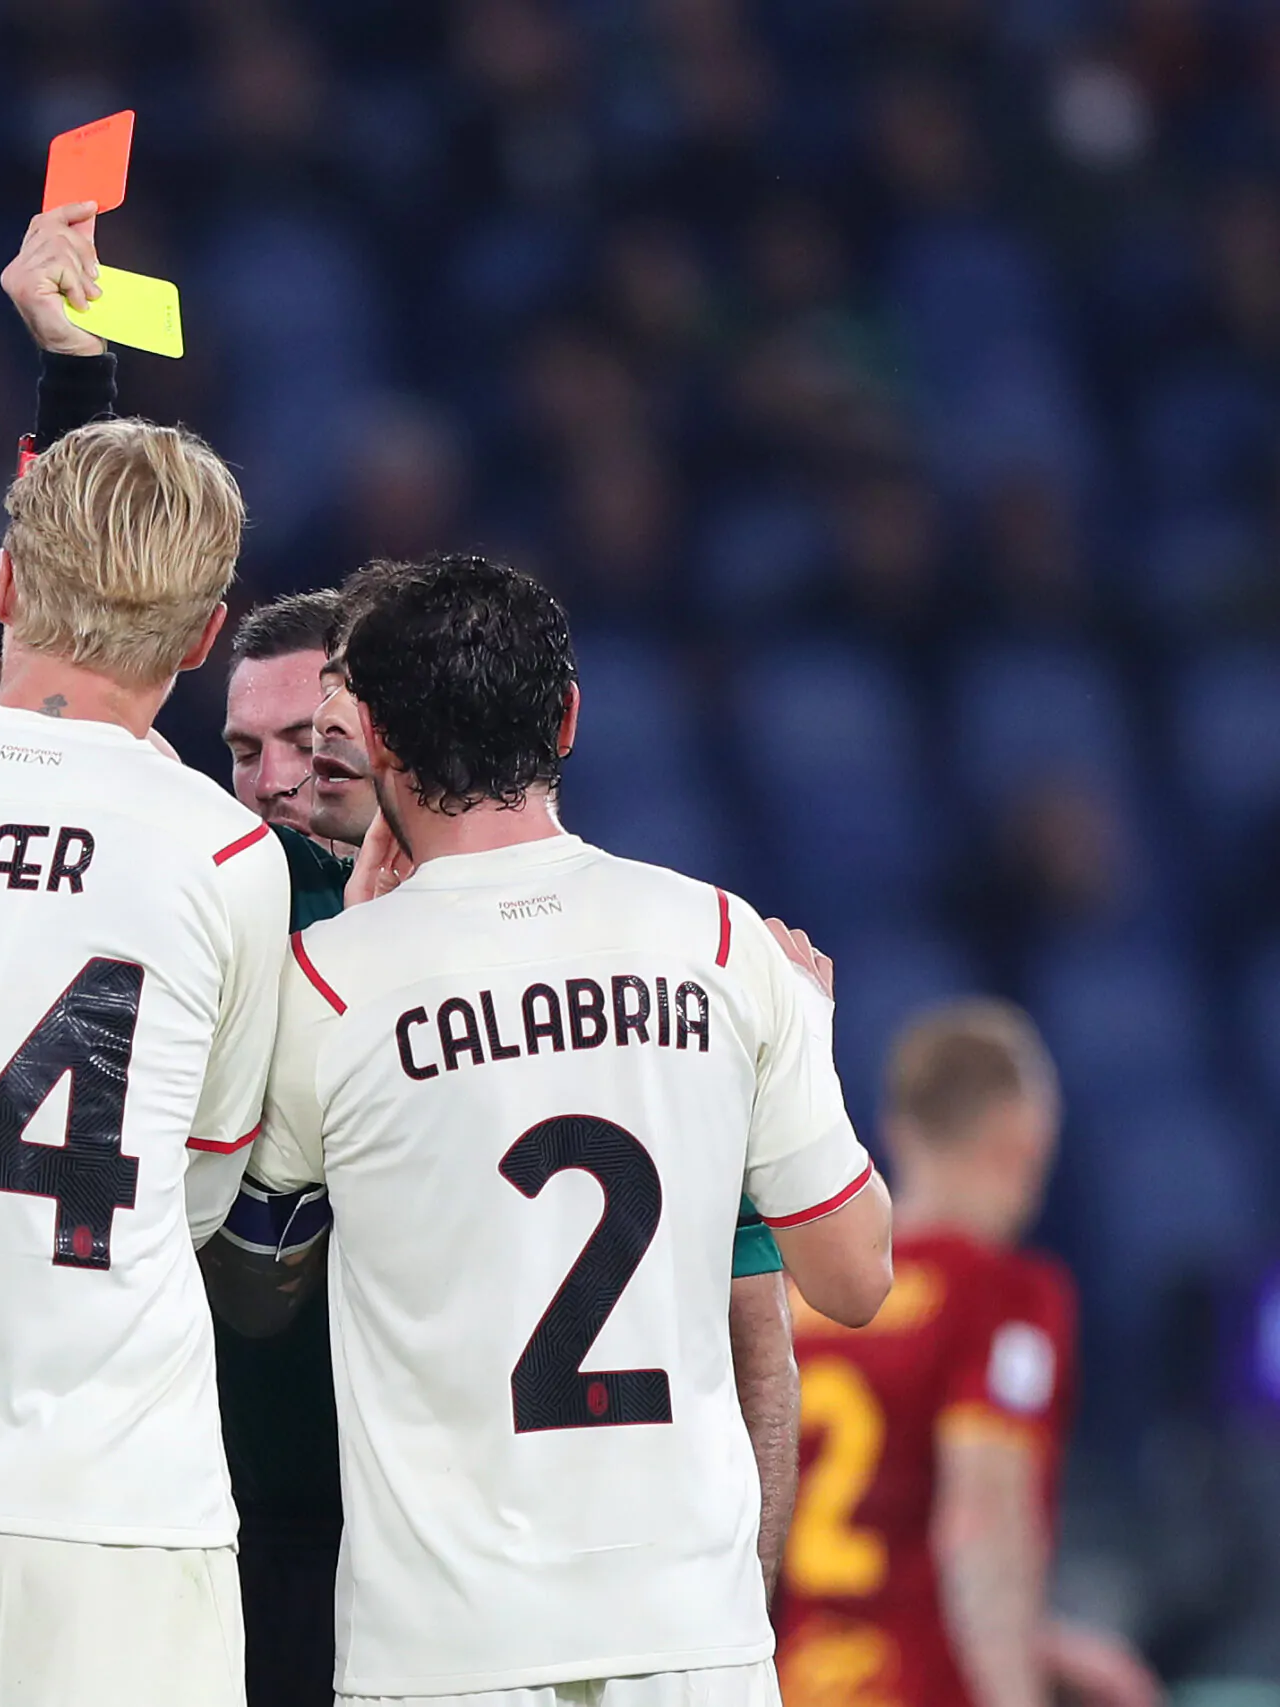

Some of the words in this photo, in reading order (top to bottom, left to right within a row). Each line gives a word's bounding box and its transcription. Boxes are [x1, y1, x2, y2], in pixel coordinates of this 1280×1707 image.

[500, 901, 562, 921] MILAN
[395, 974, 710, 1081] CALABRIA
[498, 1113, 674, 1435] 2
